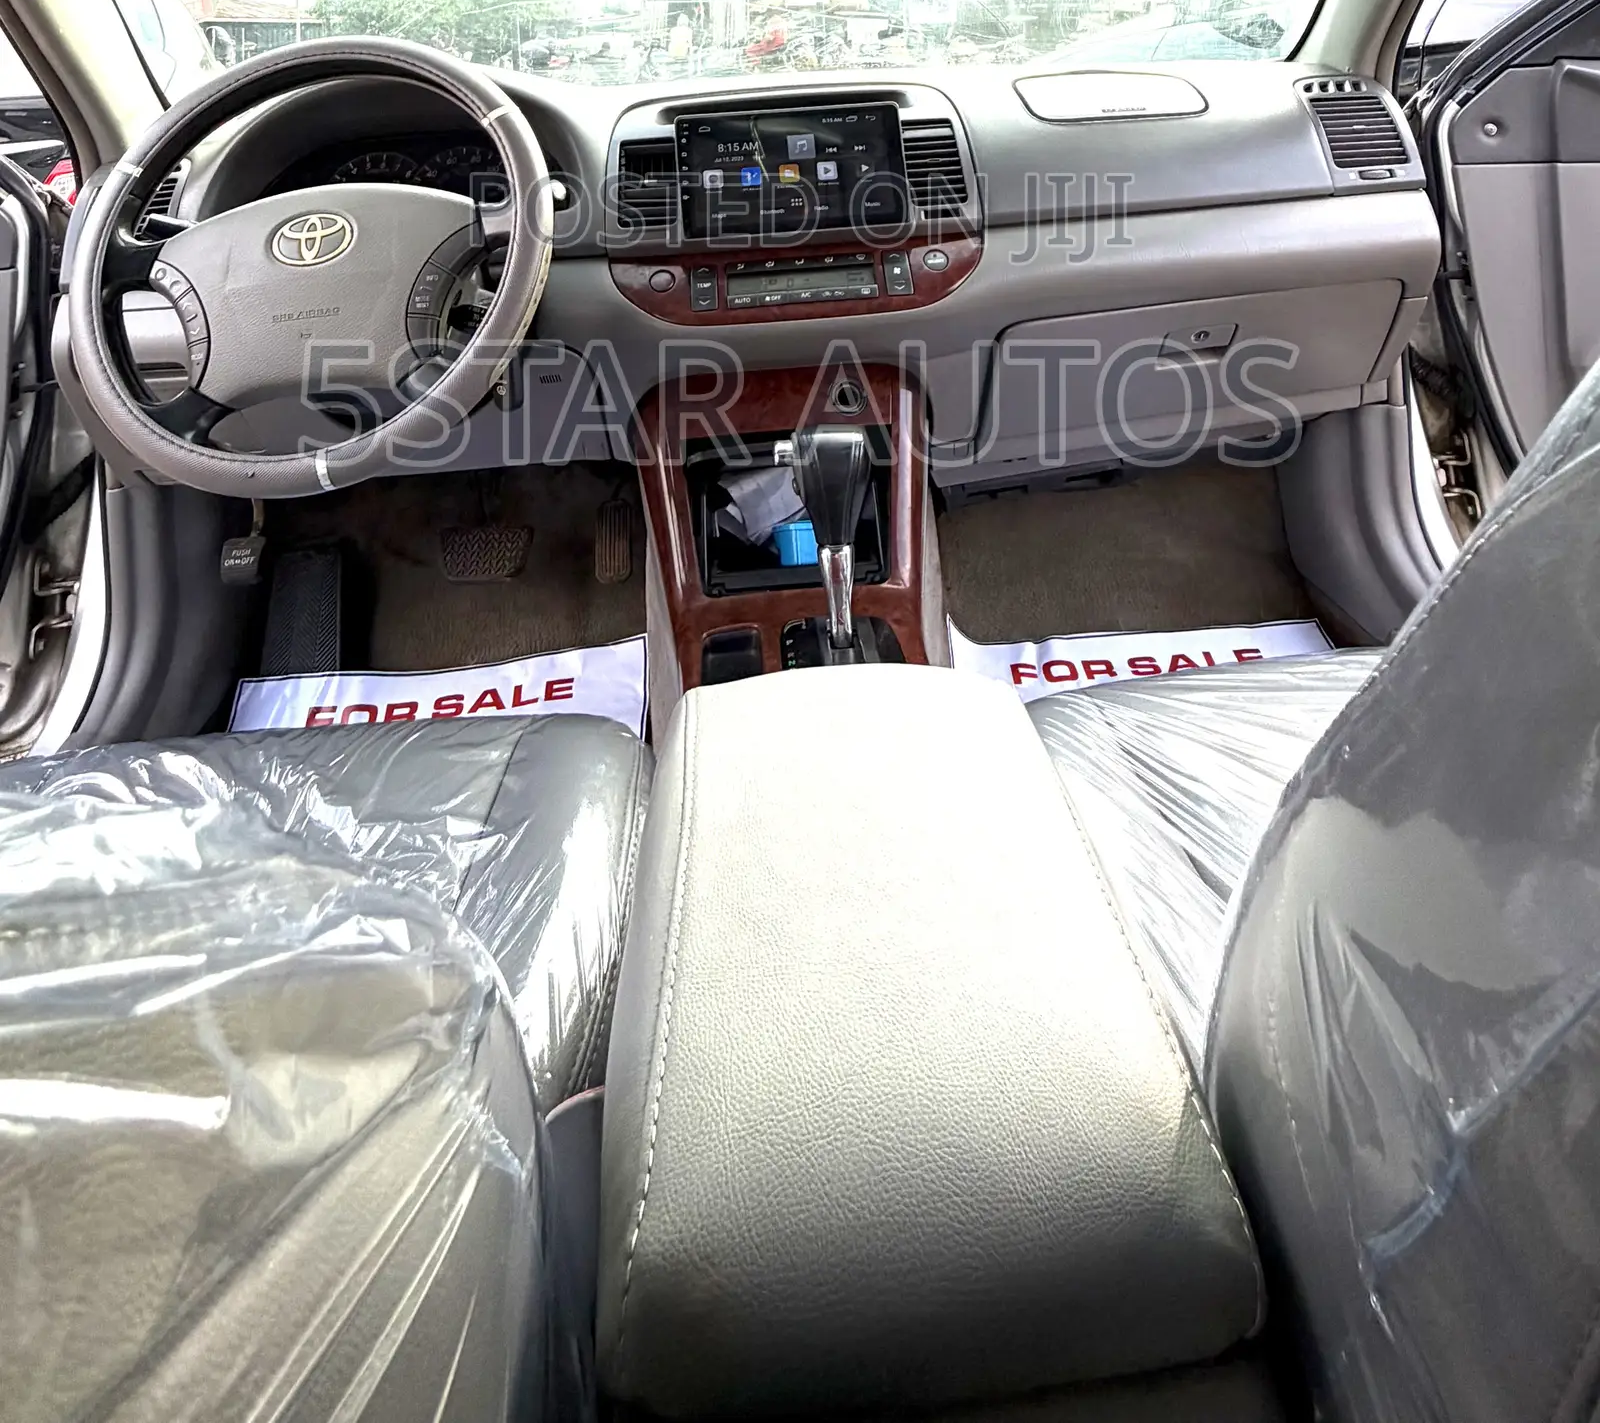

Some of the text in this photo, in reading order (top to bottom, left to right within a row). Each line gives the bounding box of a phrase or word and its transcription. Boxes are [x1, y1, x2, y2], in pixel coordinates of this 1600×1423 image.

[717, 141, 759, 153] 8:15 AM
[1010, 659, 1117, 685] FOR
[305, 678, 575, 728] FOR SALE
